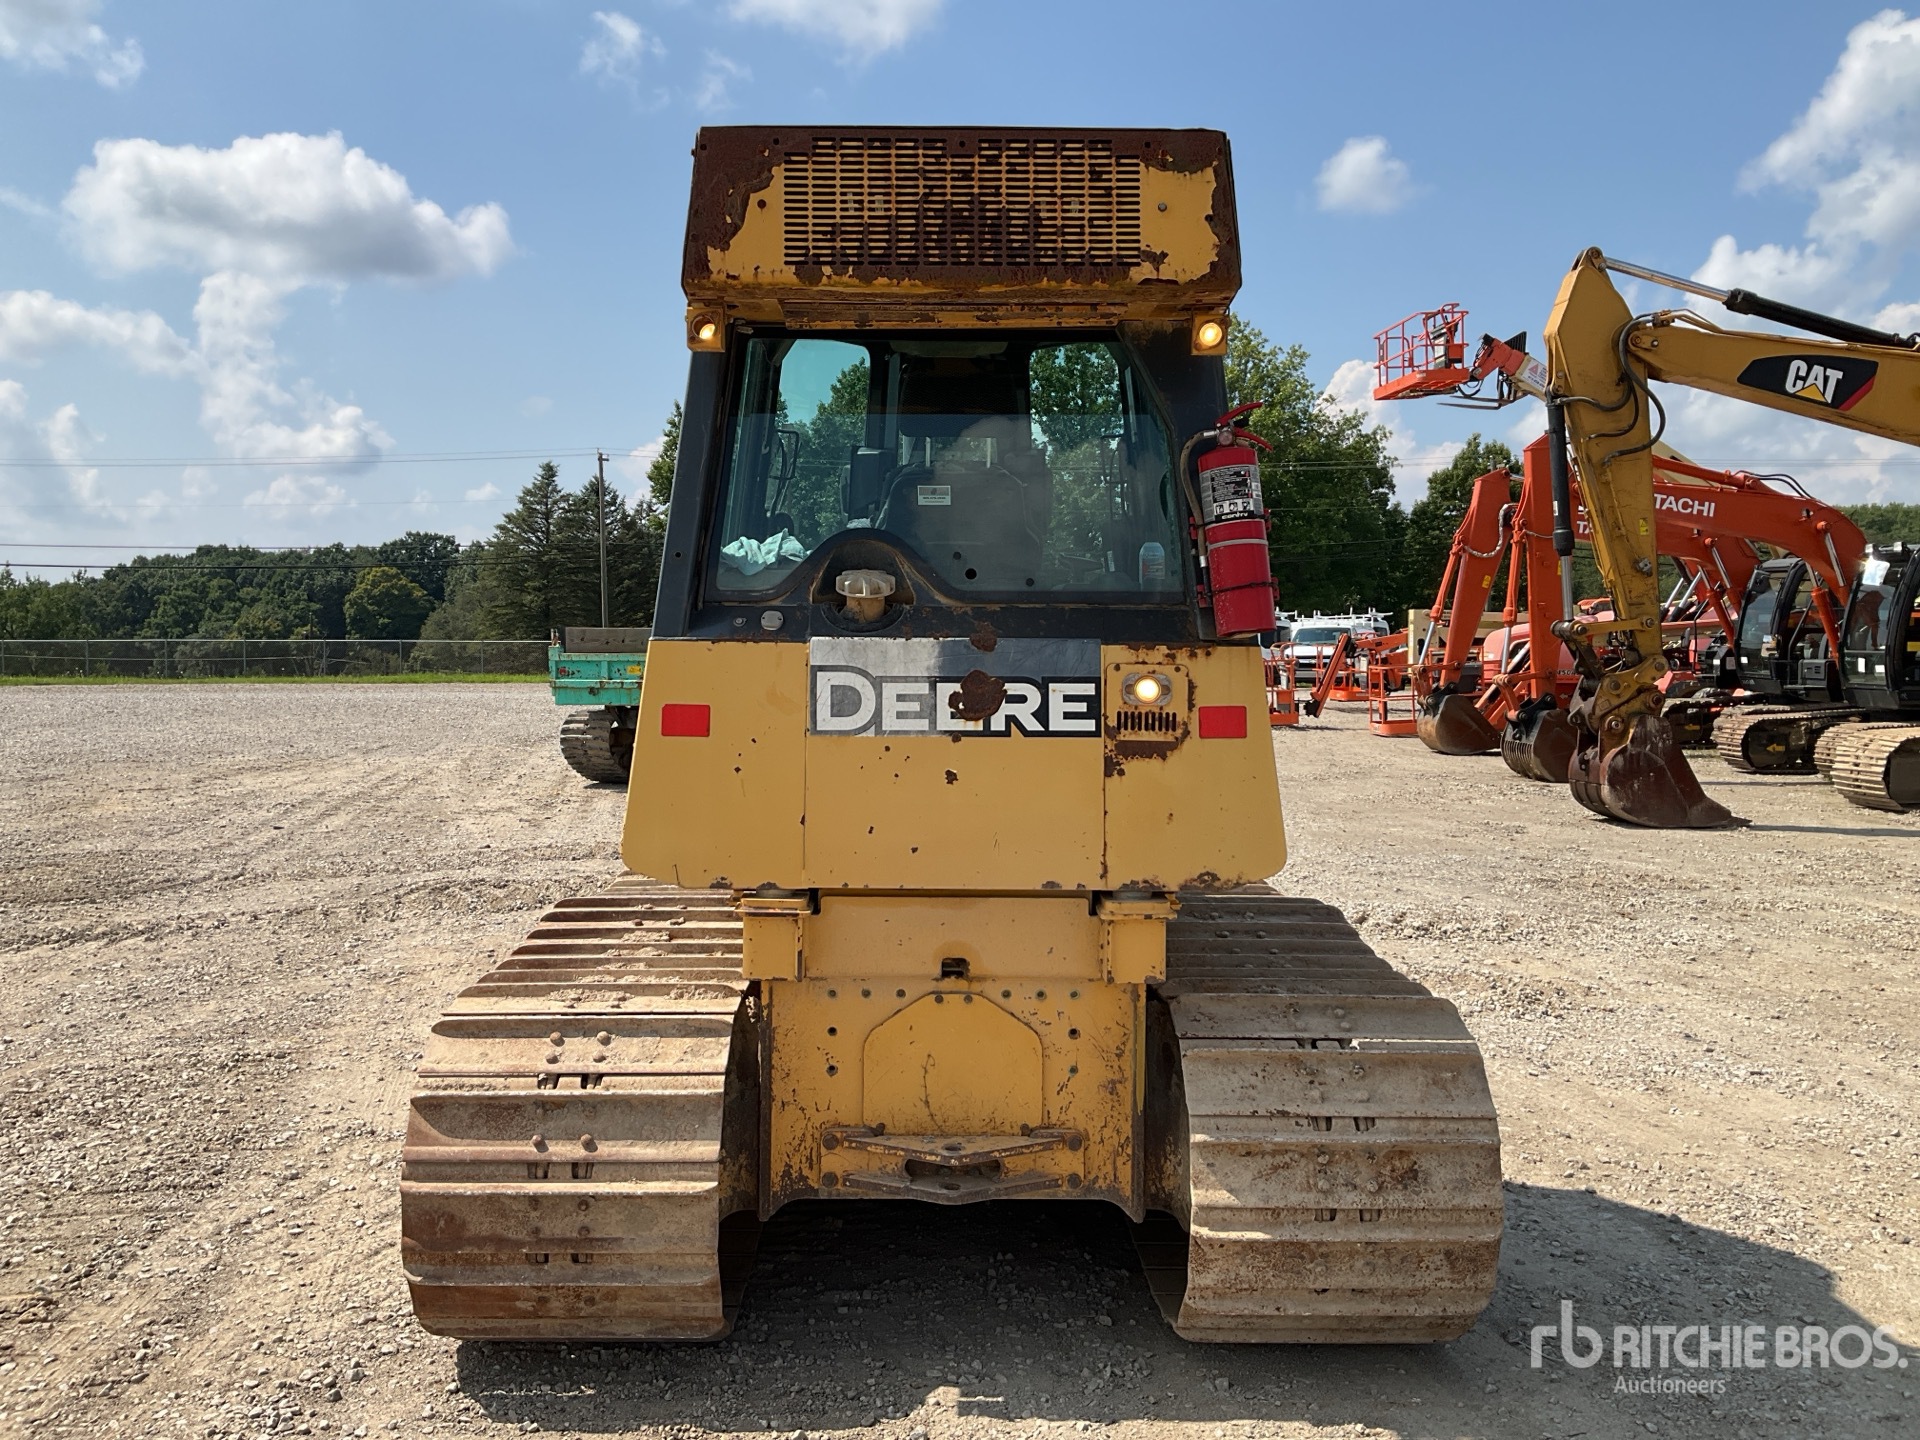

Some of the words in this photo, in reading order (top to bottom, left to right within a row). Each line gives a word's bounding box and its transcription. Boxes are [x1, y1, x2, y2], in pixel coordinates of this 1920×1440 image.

[1785, 359, 1844, 404] CAT
[1653, 492, 1716, 518] TACHI
[815, 670, 1096, 732] DEERE
